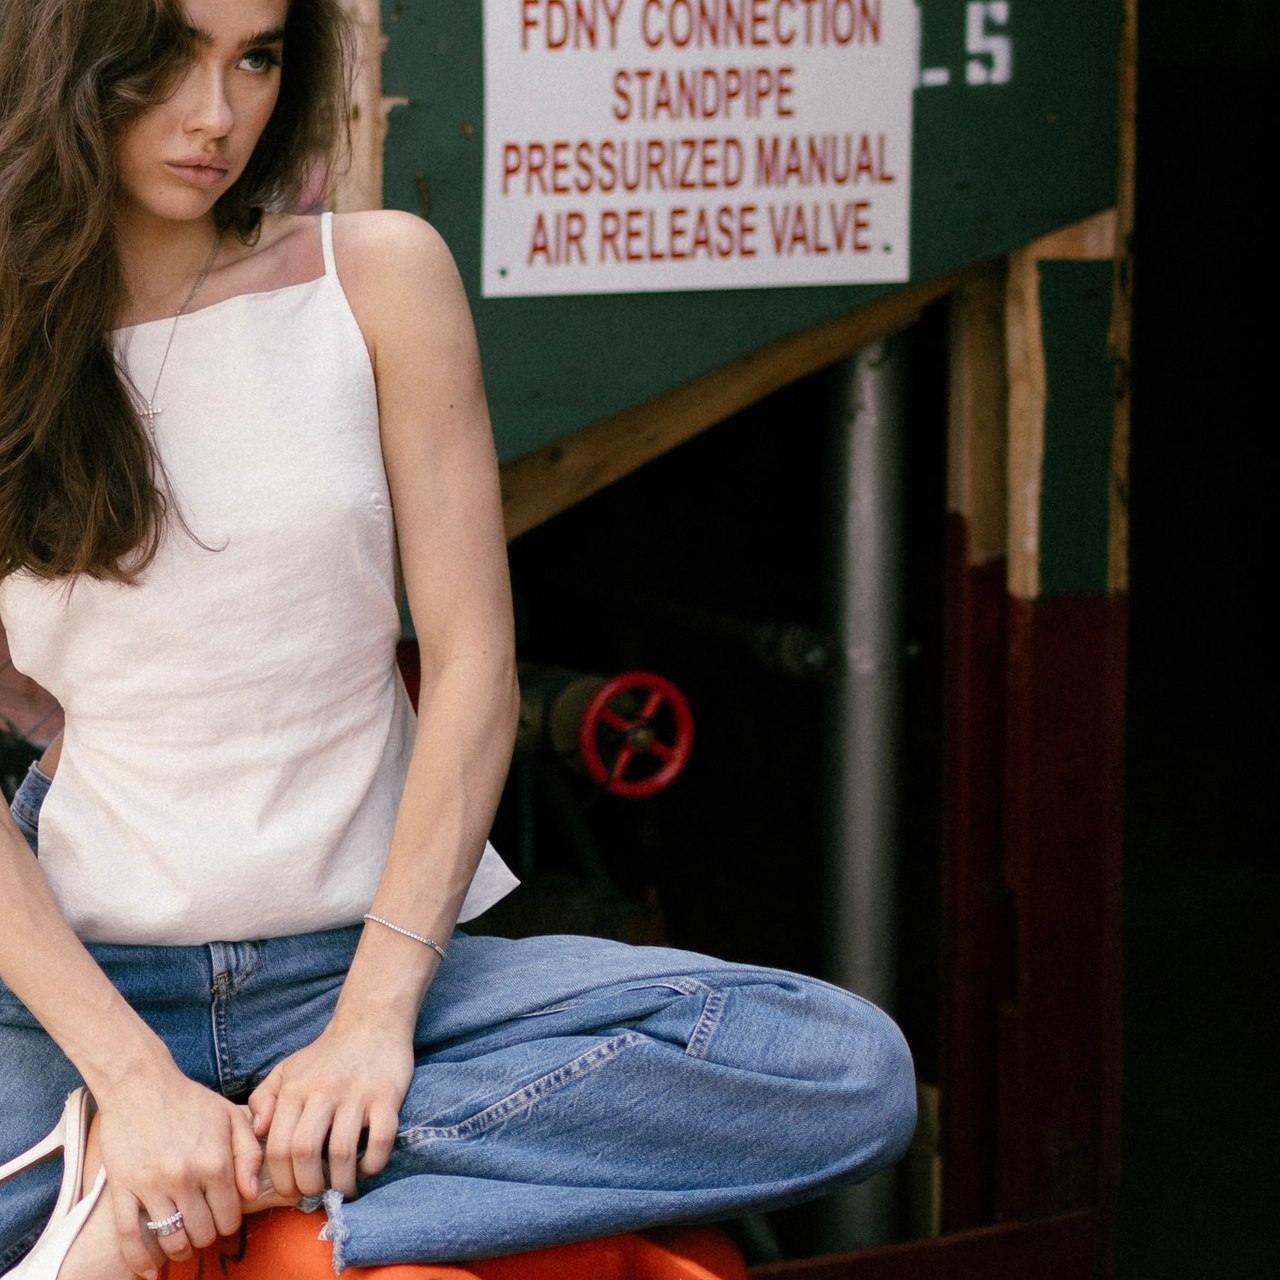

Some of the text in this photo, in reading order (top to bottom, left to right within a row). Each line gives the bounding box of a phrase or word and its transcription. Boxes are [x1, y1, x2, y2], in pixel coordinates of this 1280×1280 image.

[612, 66, 796, 123] STANDPIPE
[501, 133, 896, 197] PRESSURIZED MANUAL
[528, 200, 872, 267] AIR RELEASE VALVE
